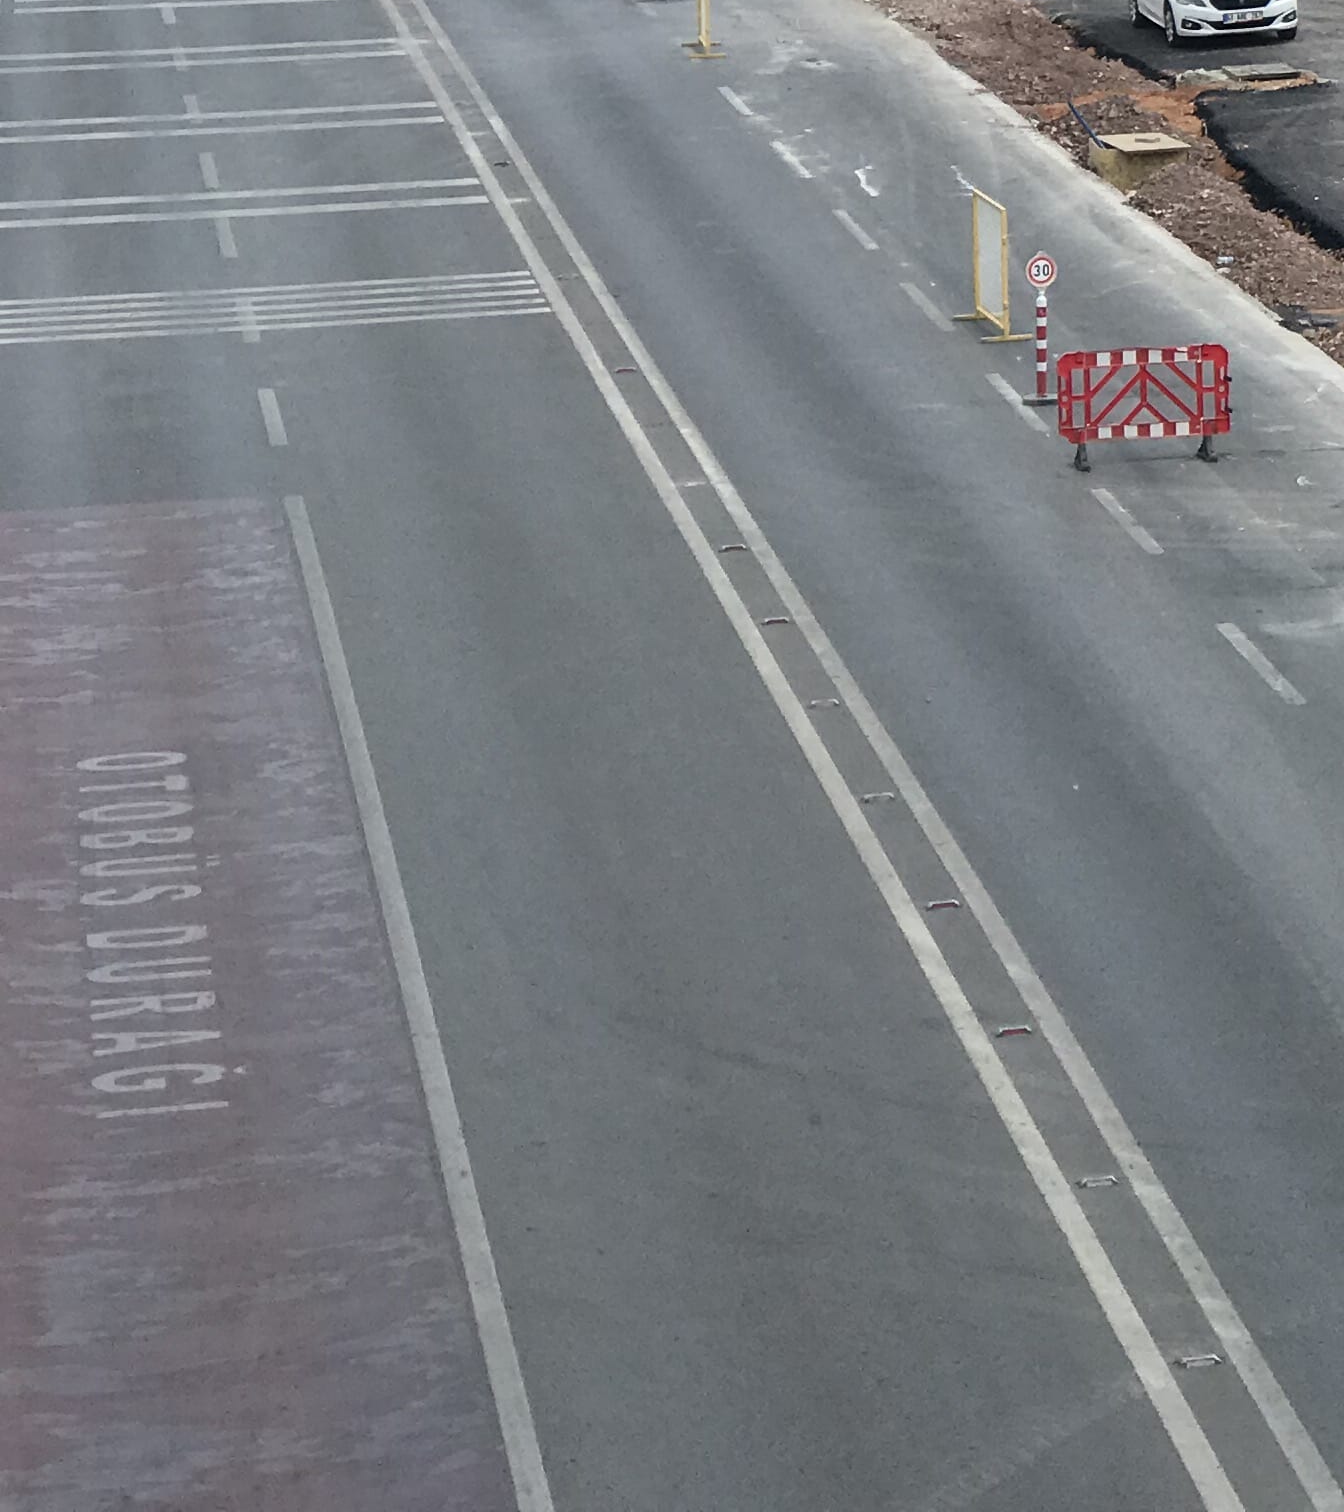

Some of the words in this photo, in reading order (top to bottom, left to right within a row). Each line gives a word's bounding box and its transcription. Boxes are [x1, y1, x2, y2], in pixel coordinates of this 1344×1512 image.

[1033, 264, 1050, 277] 30
[76, 750, 221, 906] OTOBÜS
[86, 924, 247, 1119] DURAĞI
